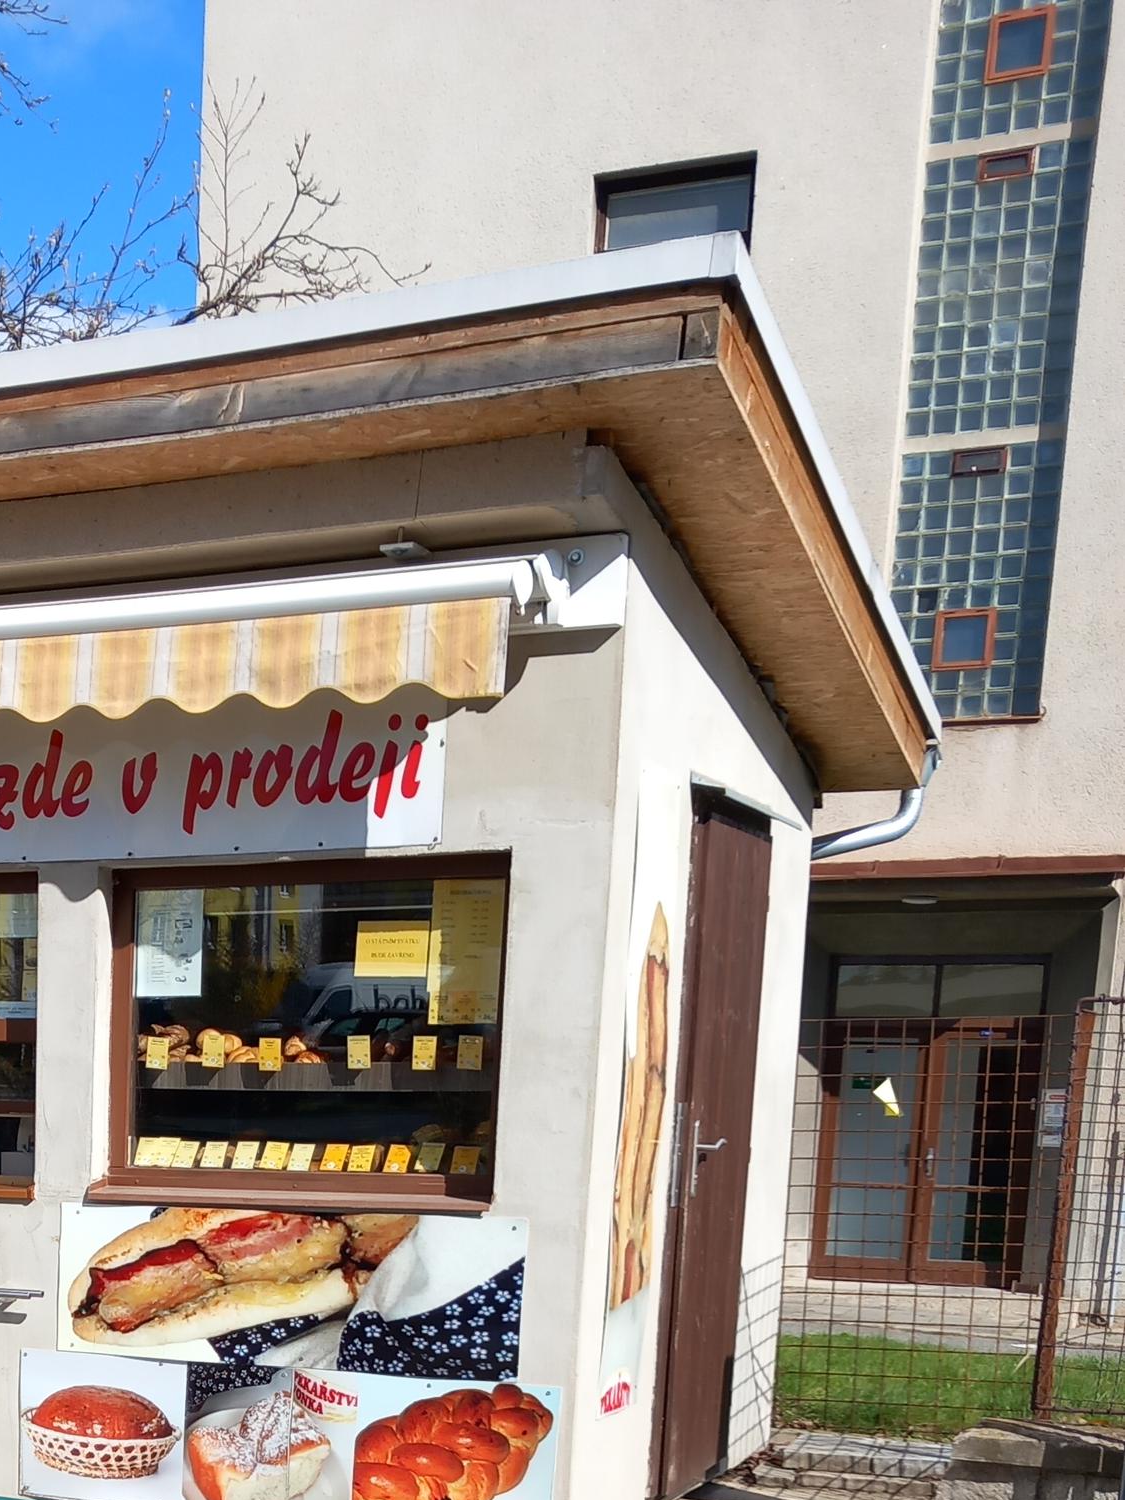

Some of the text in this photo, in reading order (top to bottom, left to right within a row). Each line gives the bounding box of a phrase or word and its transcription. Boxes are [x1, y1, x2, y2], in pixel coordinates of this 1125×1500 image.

[121, 751, 158, 815] v
[182, 708, 430, 836] prodeji
[294, 1385, 324, 1415] ONKA
